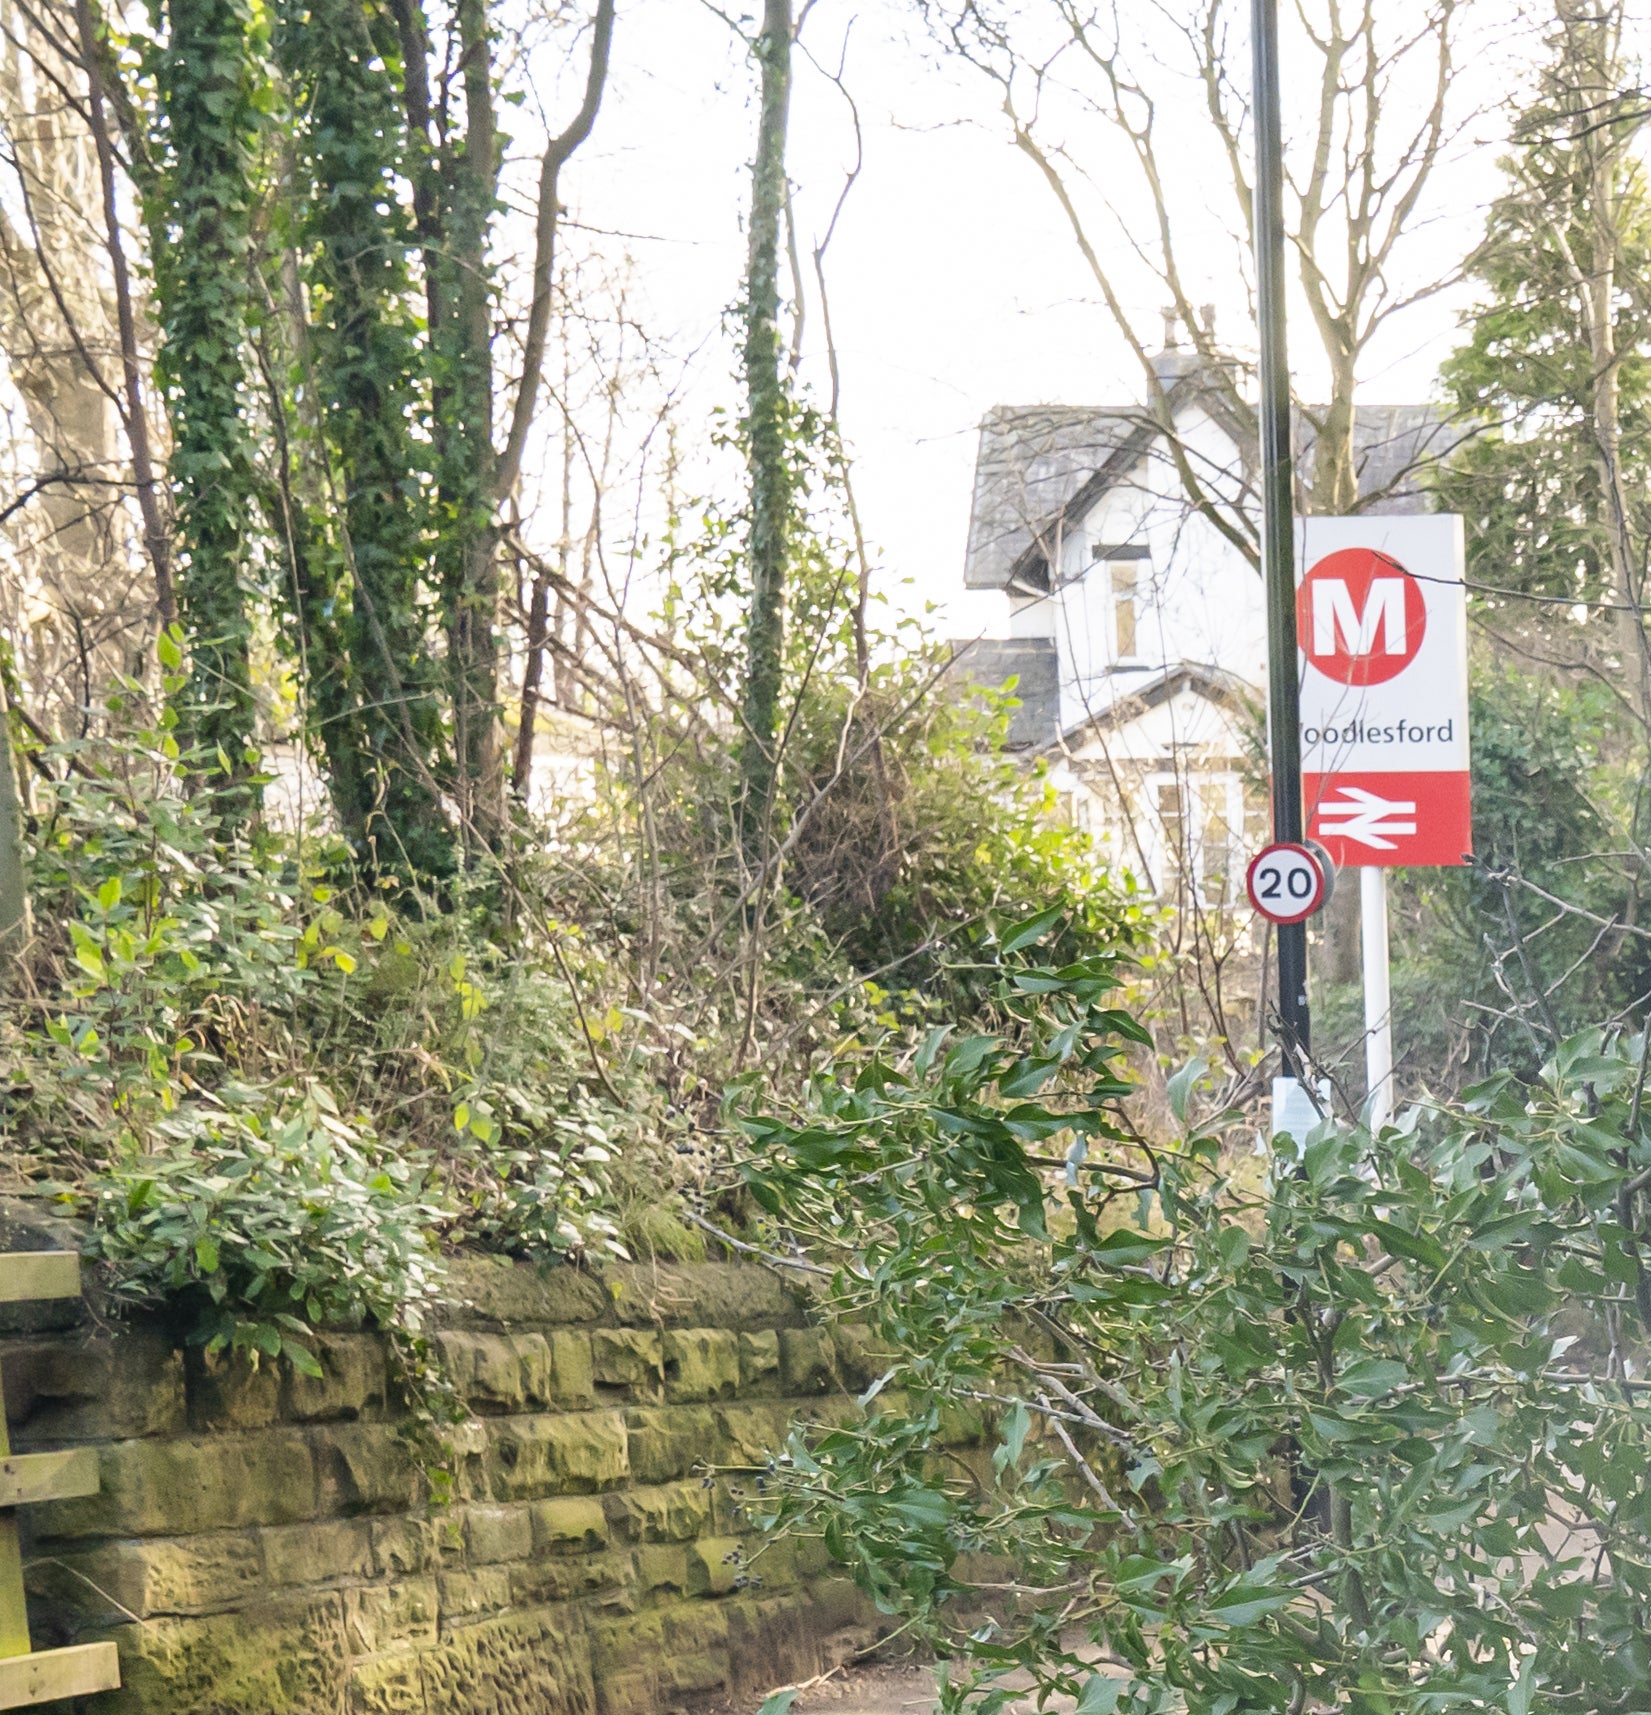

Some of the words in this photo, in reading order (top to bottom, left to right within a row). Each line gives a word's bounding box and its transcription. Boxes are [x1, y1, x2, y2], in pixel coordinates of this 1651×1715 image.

[1312, 578, 1407, 656] M
[1299, 718, 1453, 744] oodlesford
[1259, 867, 1312, 898] 20
